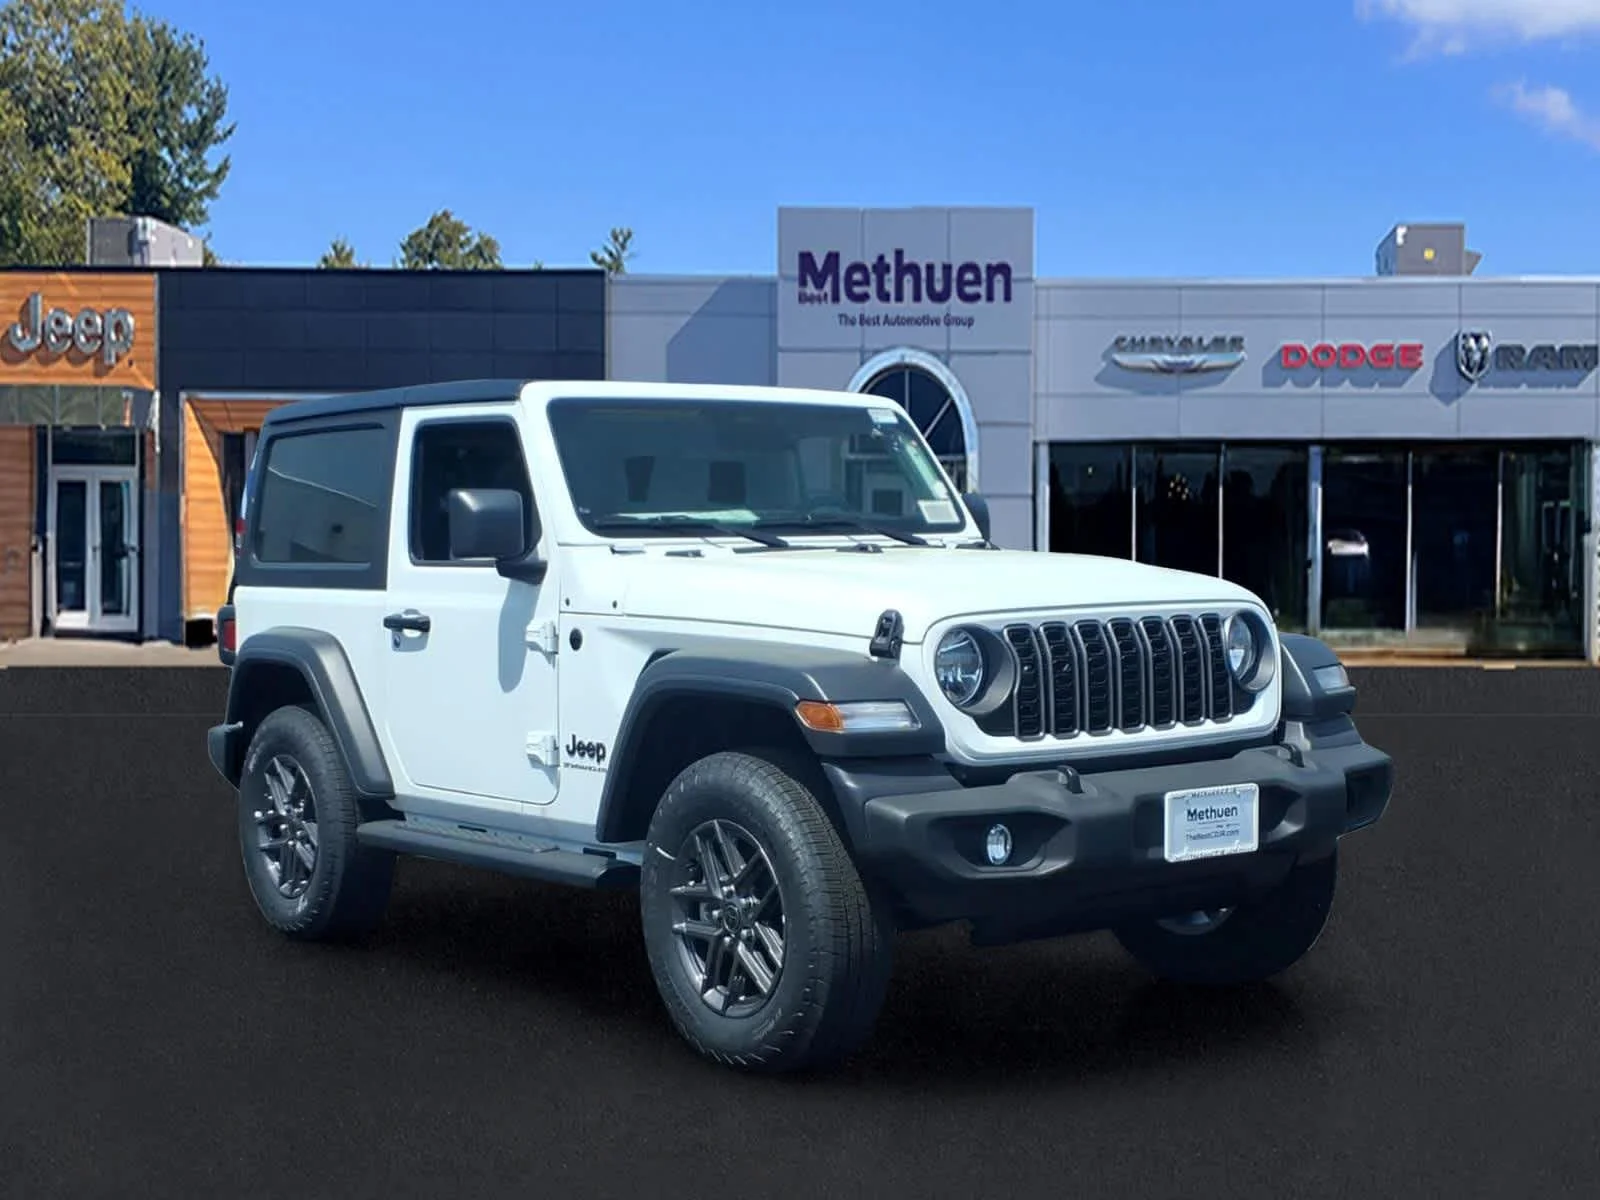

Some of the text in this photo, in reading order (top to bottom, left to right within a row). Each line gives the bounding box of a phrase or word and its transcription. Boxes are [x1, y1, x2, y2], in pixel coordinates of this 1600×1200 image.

[798, 248, 1012, 304] Methuen
[8, 292, 135, 366] Jeep
[838, 312, 975, 329] The Best Automotive Group
[1113, 335, 1245, 352] CHRYSLER
[1281, 343, 1424, 369] DODGE
[1495, 344, 1598, 371] RAM
[565, 733, 606, 765] Jeep
[1186, 806, 1239, 822] Methuen
